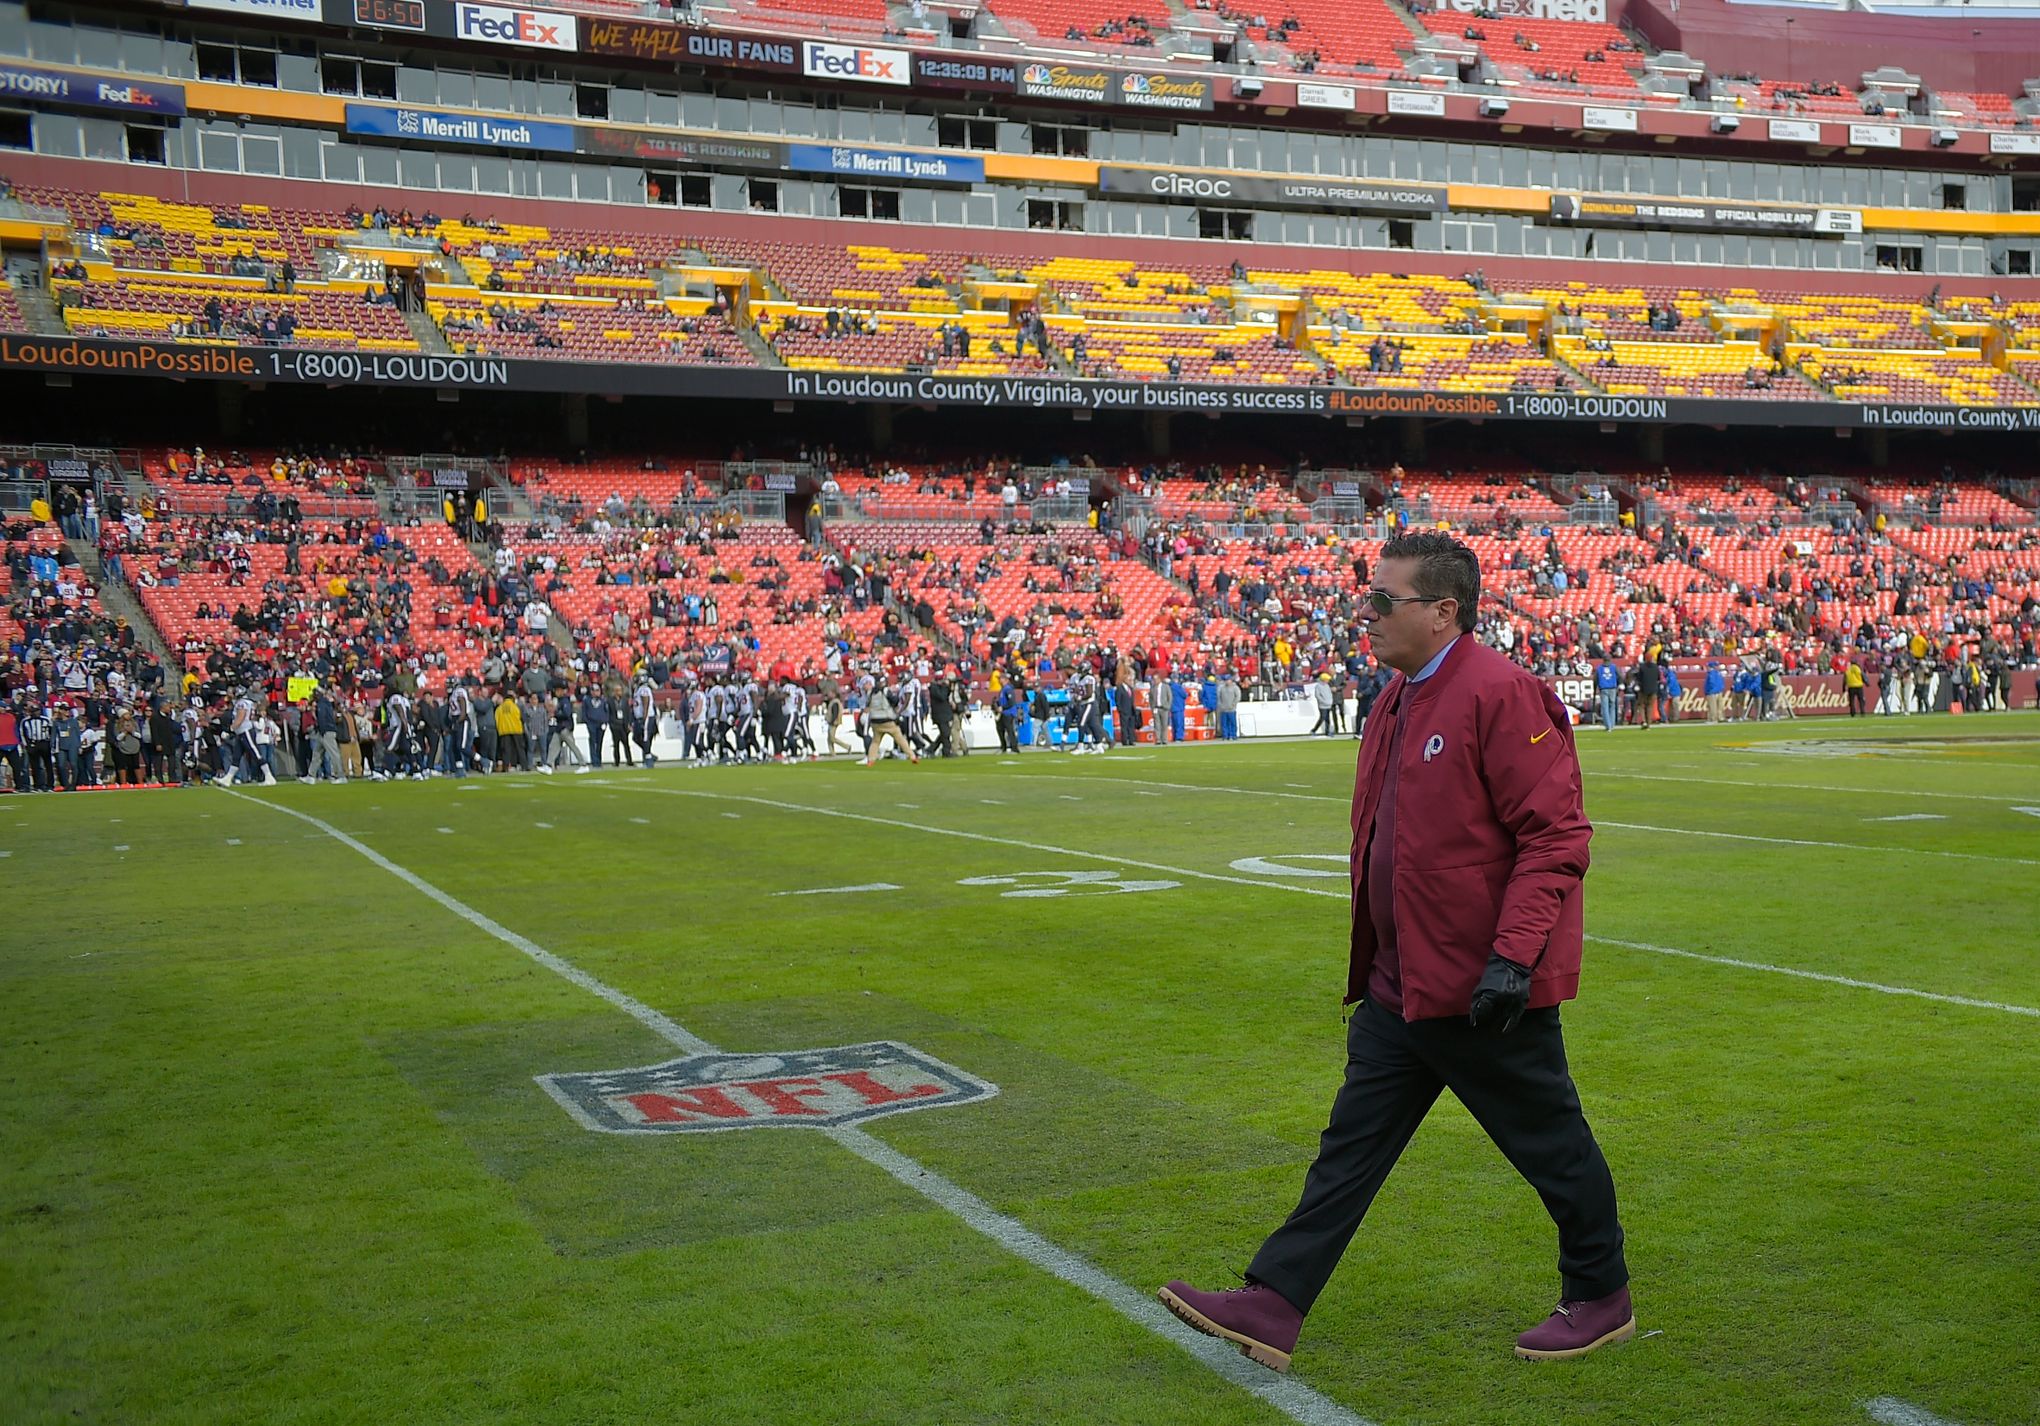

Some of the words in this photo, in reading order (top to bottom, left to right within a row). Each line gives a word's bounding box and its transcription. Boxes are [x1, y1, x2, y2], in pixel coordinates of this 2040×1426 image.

[358, 0, 421, 25] 26:50
[463, 6, 560, 45] FedEx
[590, 23, 624, 50] WE
[630, 26, 684, 59] HAIL
[688, 35, 733, 59] OUR
[738, 40, 794, 65] FANS
[810, 46, 893, 79] FedEx
[918, 60, 986, 82] 12:35:09
[990, 66, 1016, 84] PM
[1049, 66, 1109, 90] Sports
[1147, 75, 1205, 98] Sports
[98, 84, 154, 106] FedEx
[1026, 84, 1105, 101] WASHINGTON
[1124, 93, 1203, 108] WASHINGTON
[422, 117, 477, 139] Merrill
[482, 123, 531, 144] Lynch
[667, 141, 697, 154] THE
[700, 143, 771, 160] REDSKINS
[853, 153, 901, 173] Merrill
[905, 156, 947, 177] Lynch
[1150, 173, 1232, 197] CÎROC
[1285, 184, 1327, 198] ULTRA
[1328, 187, 1390, 202] PREMIUM
[1390, 190, 1435, 205] VODKA
[2, 336, 261, 377] LoudounPossible.
[269, 352, 508, 386] 1-(800)-LOUDOUN
[786, 373, 808, 395] In
[815, 374, 913, 399] Loudoun
[917, 378, 1000, 404] County,
[1003, 380, 1087, 407] Virginia,
[1091, 387, 1139, 407] your
[1142, 384, 1229, 408] business
[1231, 390, 1306, 409] success
[1308, 390, 1325, 409] is
[1329, 391, 1502, 416] #LoudounPossible.
[1507, 395, 1667, 418] 1-(800)-LOUDOUN
[1862, 405, 1879, 423] In
[1883, 405, 1955, 425] Loudoun
[1957, 407, 2020, 431] County,
[1776, 682, 1850, 711] Redskins
[609, 1070, 944, 1124] NFL
